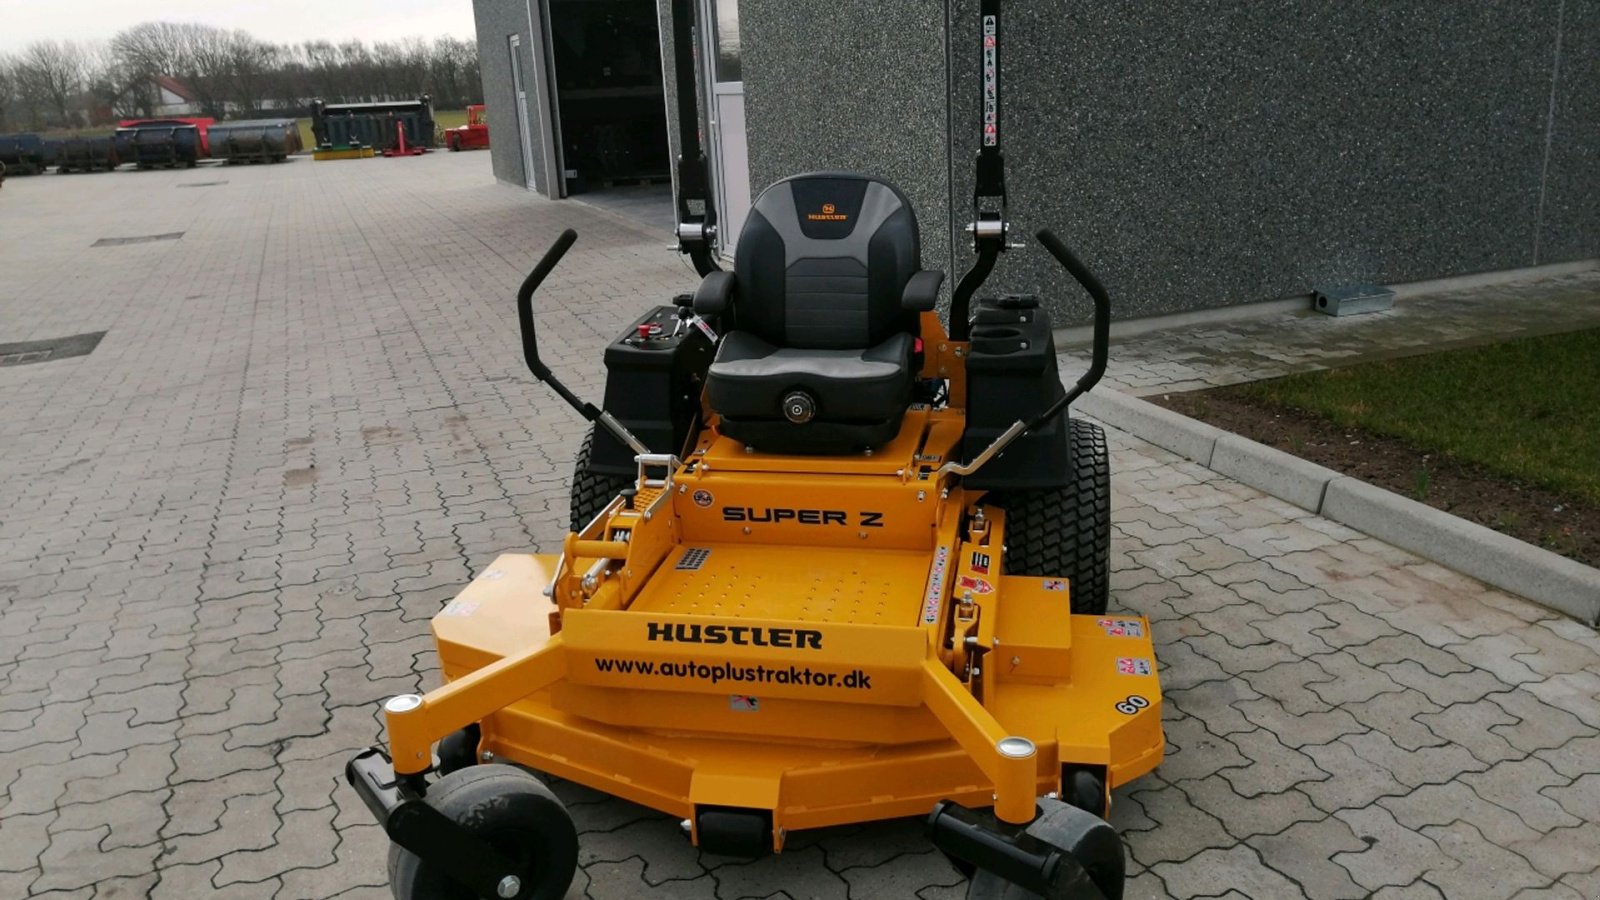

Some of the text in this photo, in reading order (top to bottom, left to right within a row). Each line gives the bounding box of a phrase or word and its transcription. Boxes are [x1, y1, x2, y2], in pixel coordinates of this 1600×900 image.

[722, 506, 883, 527] SUPER Z
[647, 622, 822, 649] HUSTLER
[594, 657, 872, 690] www.autoplustraktor.dk
[1115, 695, 1149, 715] 60
